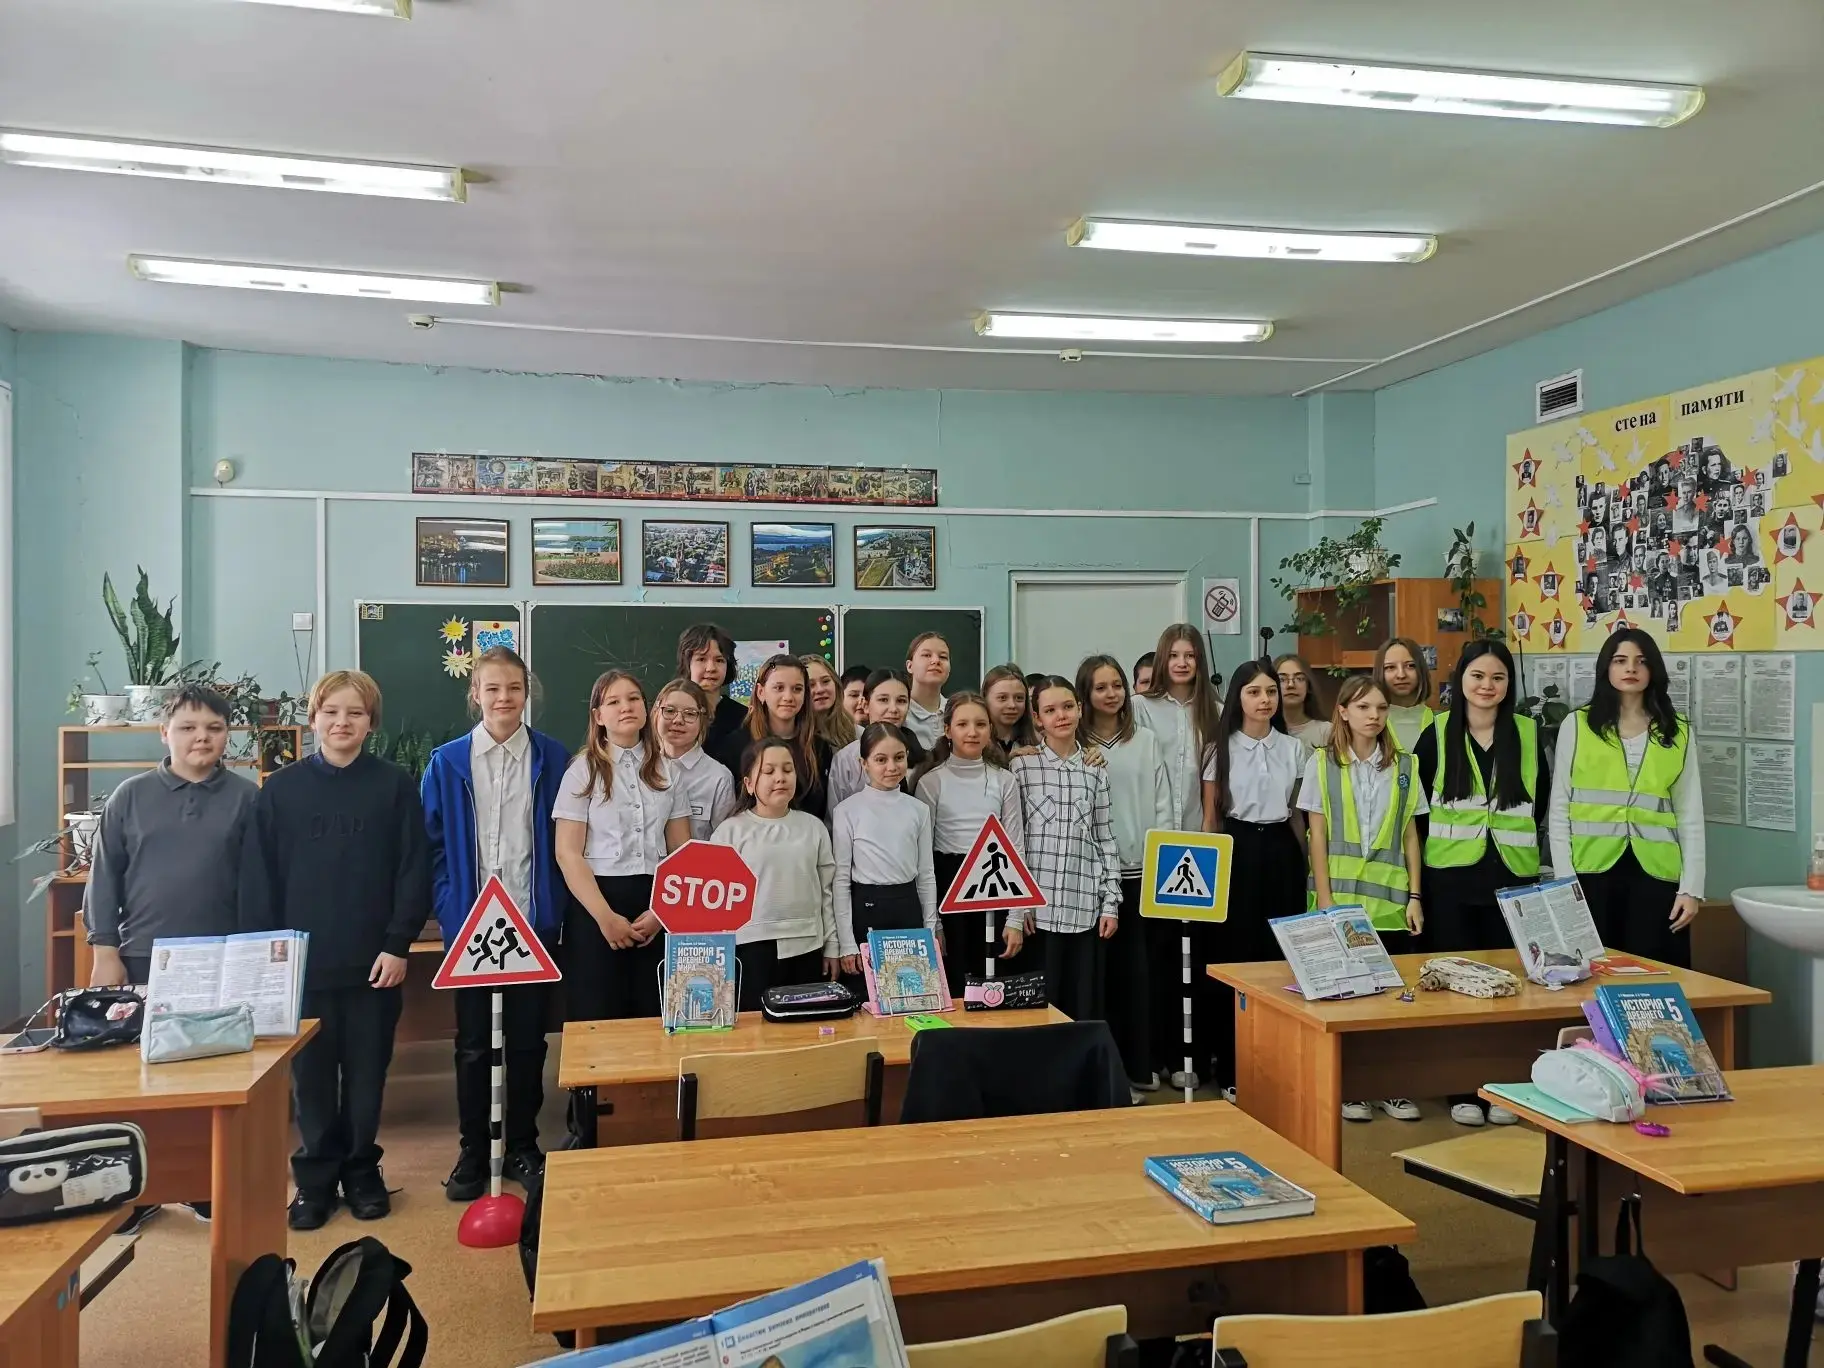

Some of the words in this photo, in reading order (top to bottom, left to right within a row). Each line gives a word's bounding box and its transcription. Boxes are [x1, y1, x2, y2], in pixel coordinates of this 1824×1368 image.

[1681, 389, 1745, 417] памяти
[661, 874, 747, 911] STOP
[882, 939, 916, 949] ИСТОРИЯ
[917, 939, 928, 957] 5
[677, 946, 714, 957] ИСТОРИЯ
[716, 946, 726, 966] 5
[677, 956, 710, 964] ДРЕВНЕГО
[1018, 989, 1036, 997] PEACH
[1620, 998, 1665, 1011] ИСТОРИЯ
[1664, 997, 1684, 1022] 5
[1626, 1009, 1665, 1020] ДРЕВНЕГО
[1224, 1157, 1248, 1169] 5
